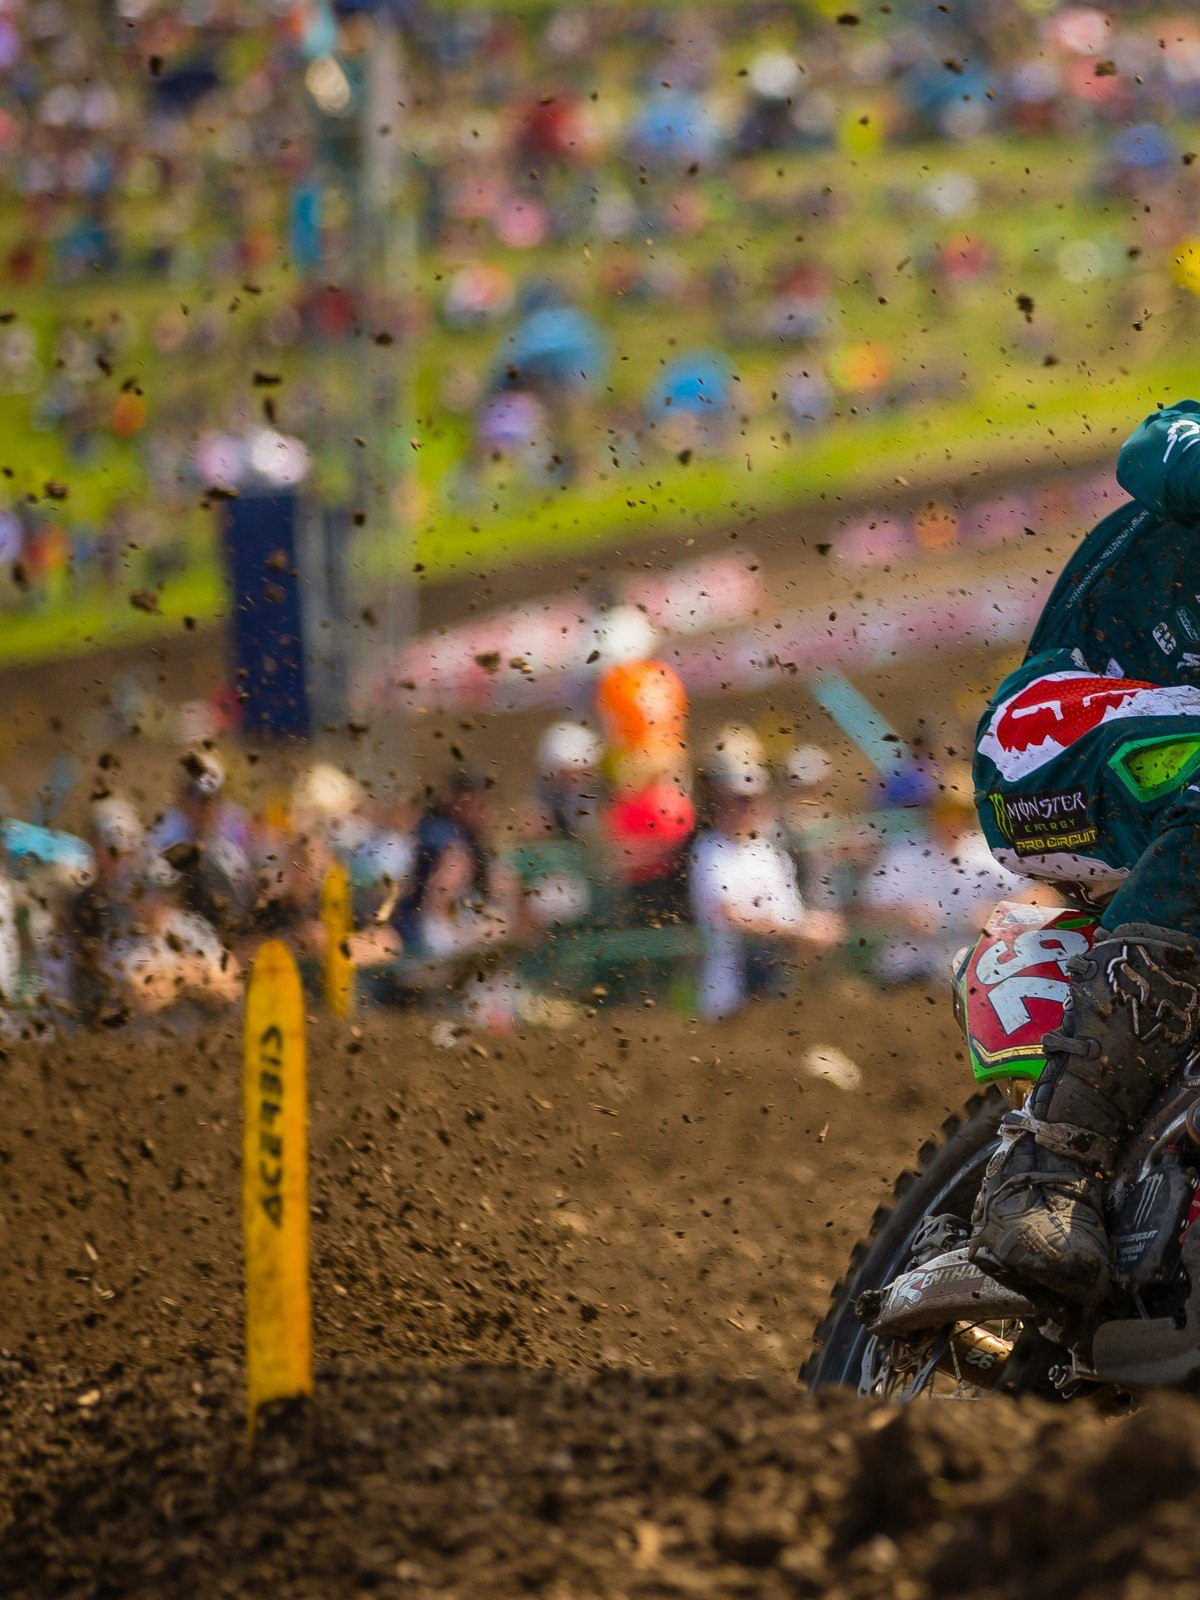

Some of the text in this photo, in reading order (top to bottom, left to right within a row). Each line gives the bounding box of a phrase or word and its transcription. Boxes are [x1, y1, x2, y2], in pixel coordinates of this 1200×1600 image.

[1006, 791, 1086, 821] MONSTER
[1024, 818, 1077, 833] ENERGY
[1016, 829, 1096, 852] PRO CIRCUIT
